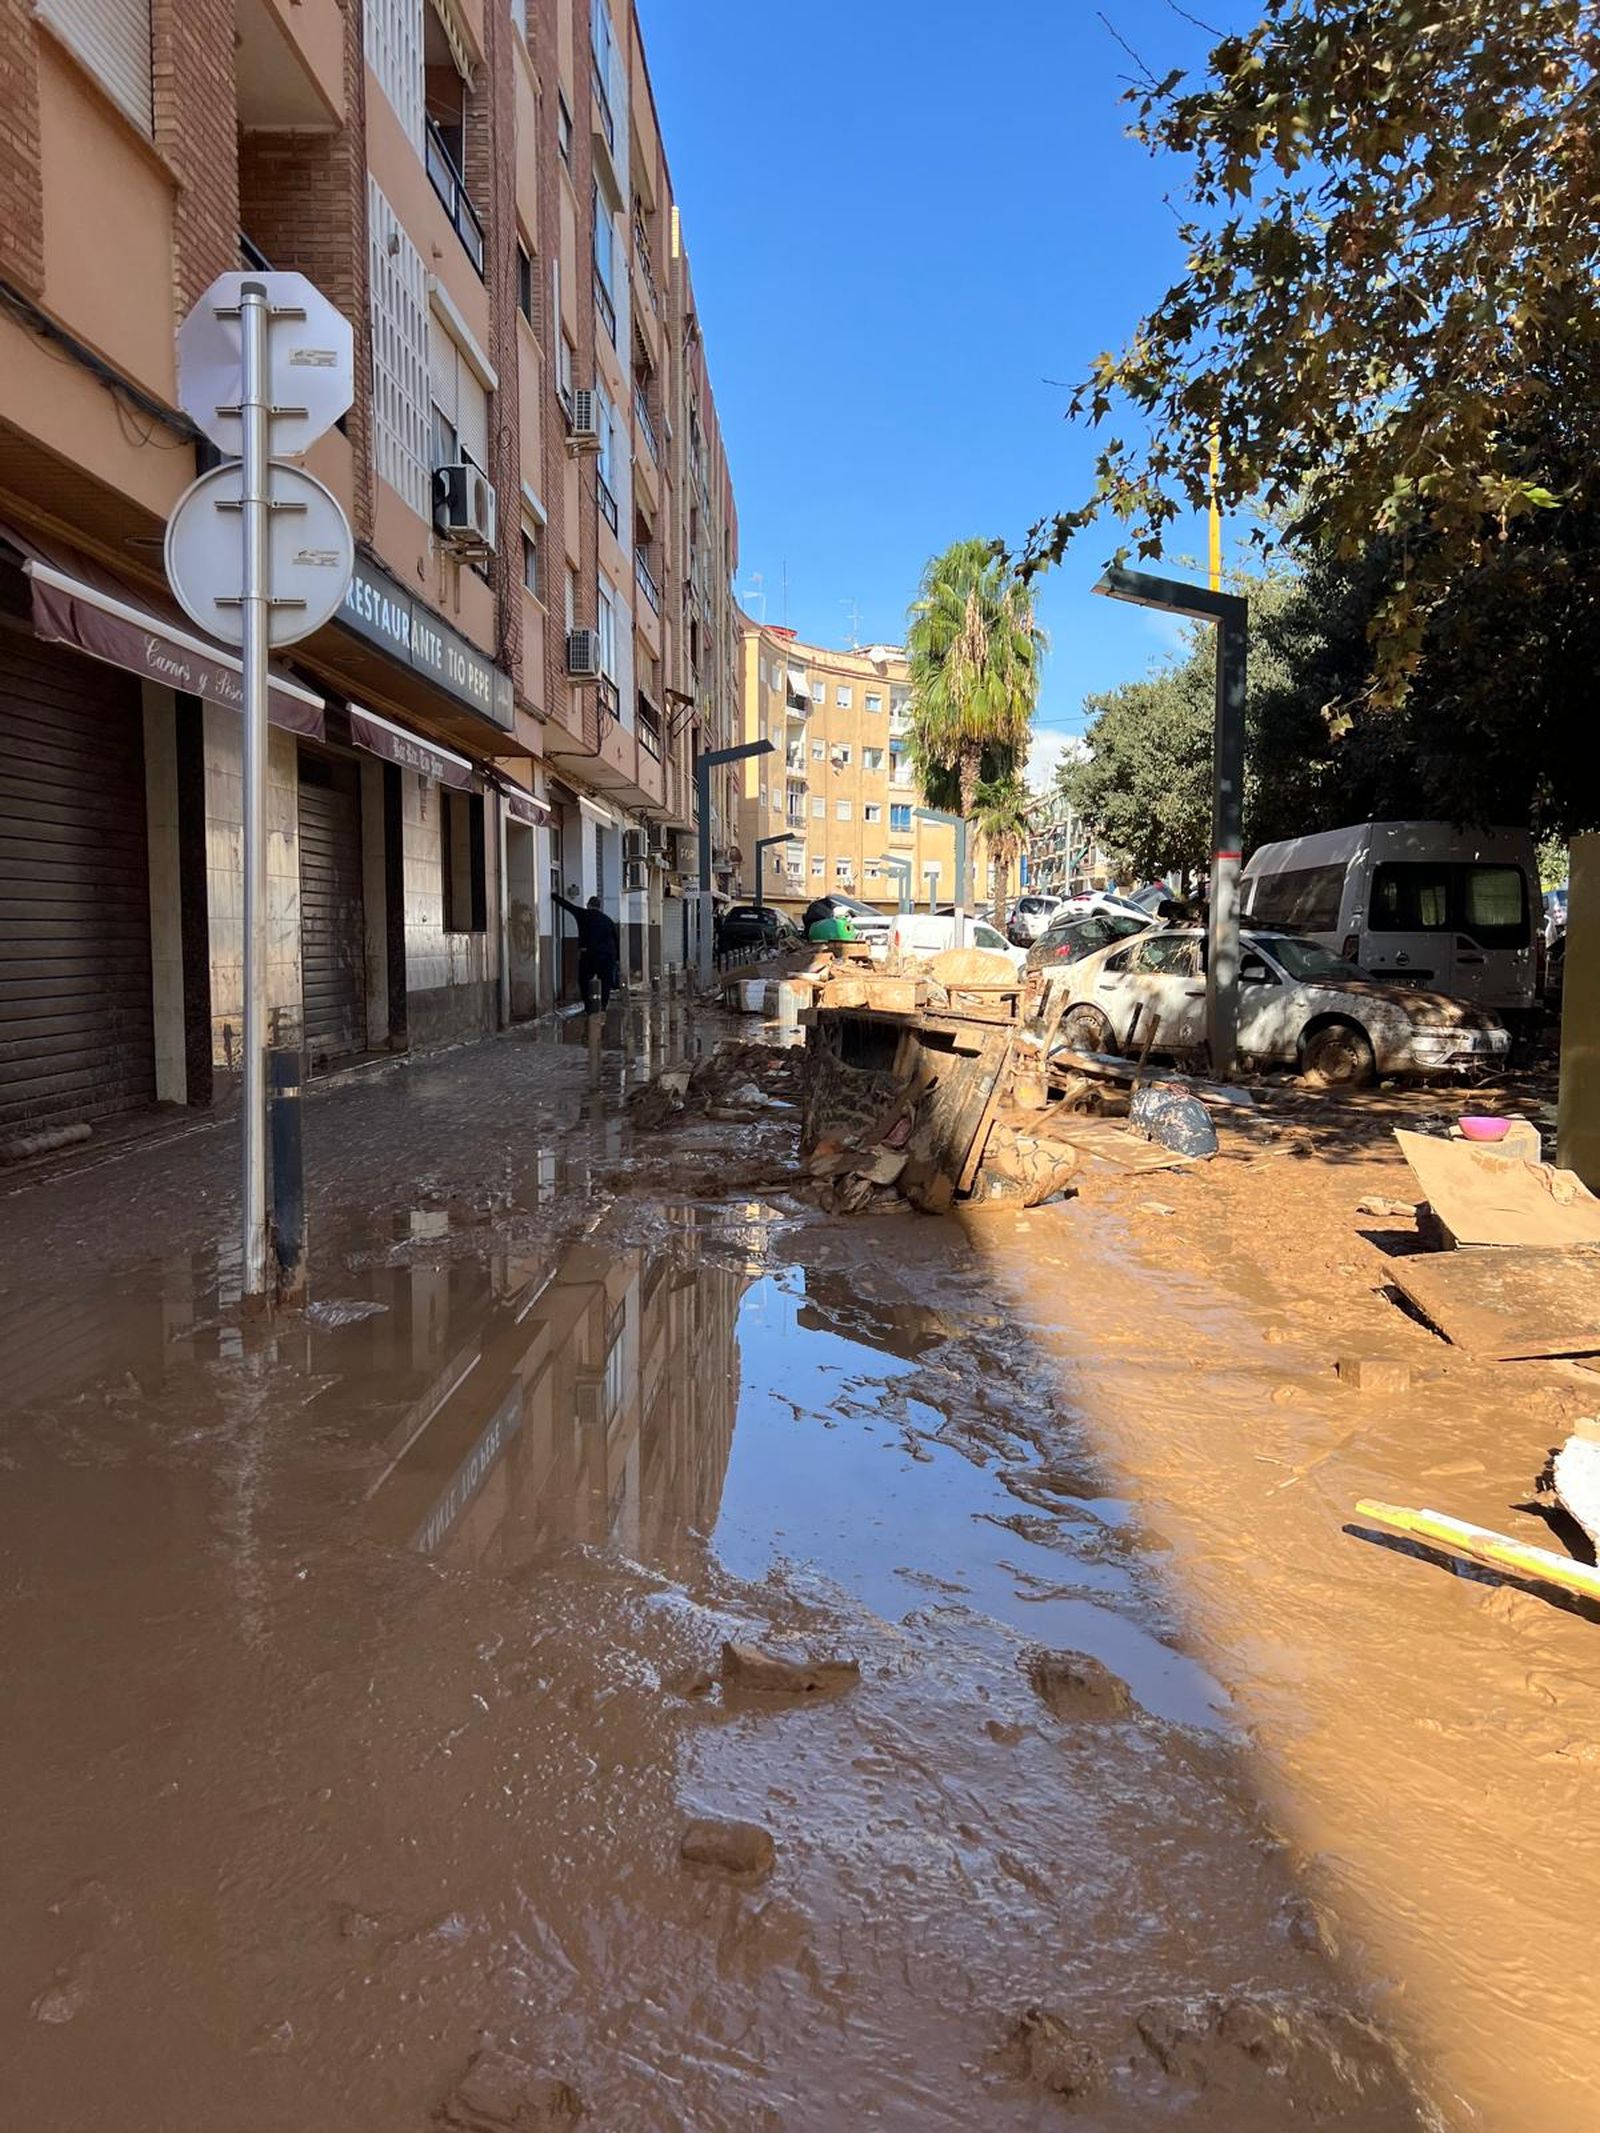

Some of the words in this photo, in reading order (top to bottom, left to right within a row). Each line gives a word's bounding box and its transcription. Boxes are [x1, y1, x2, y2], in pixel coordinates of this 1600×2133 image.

[346, 577, 442, 670] RESTAURANTE
[448, 648, 465, 686] TIO
[468, 663, 489, 702] PEPE
[199, 673, 209, 694] y
